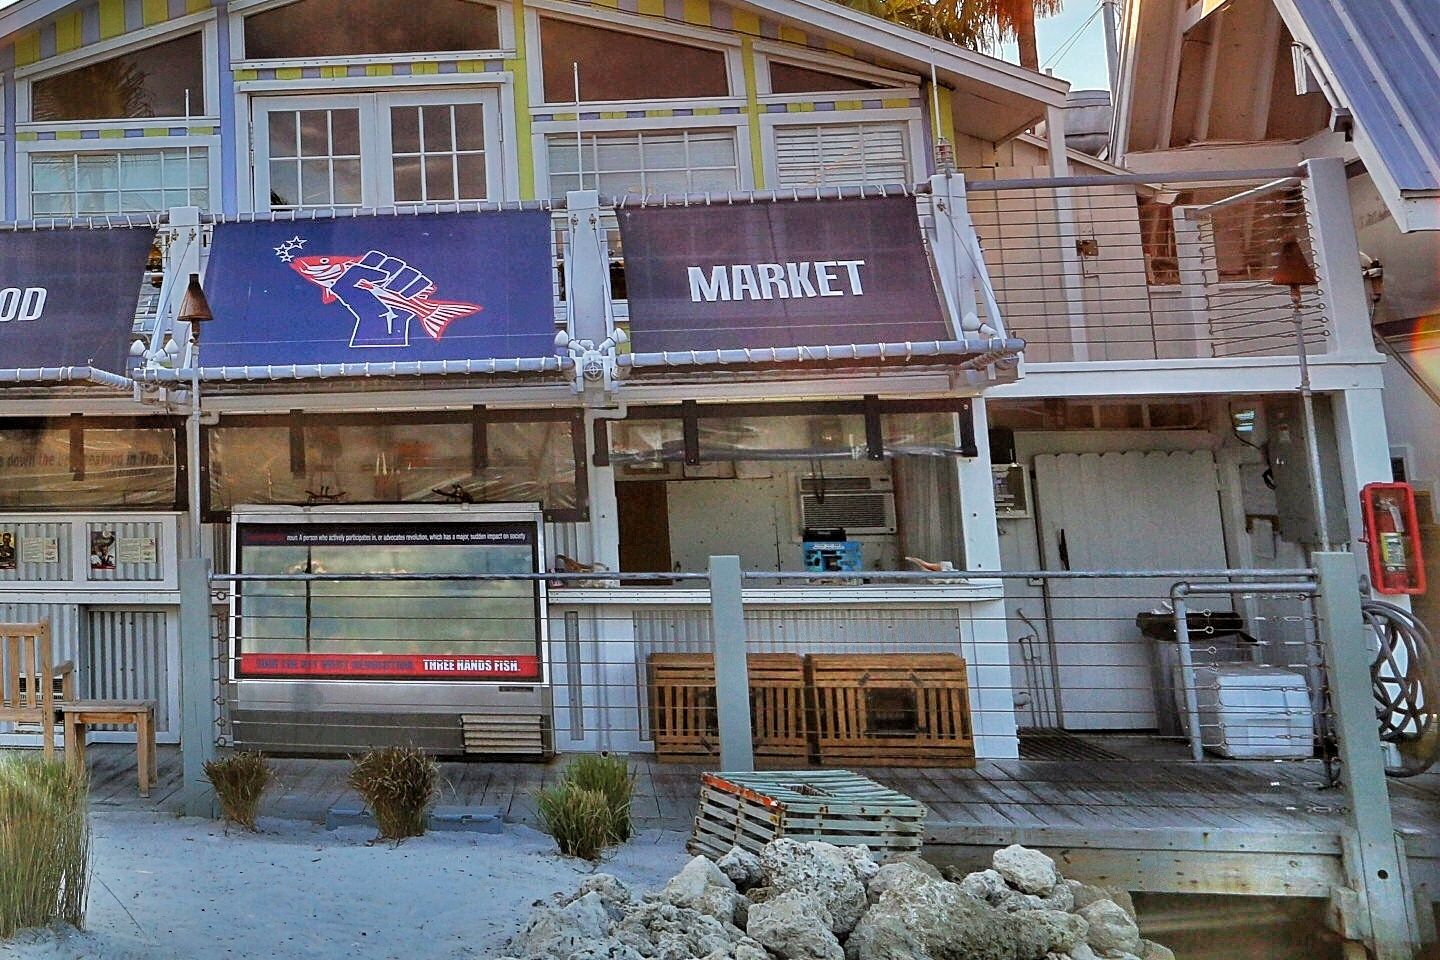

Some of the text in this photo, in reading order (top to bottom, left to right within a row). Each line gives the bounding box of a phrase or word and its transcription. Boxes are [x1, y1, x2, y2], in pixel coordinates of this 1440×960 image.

[687, 260, 865, 302] MARKET
[423, 659, 455, 671] THREE
[457, 659, 492, 671] HANDS
[494, 660, 521, 672] FISH.
